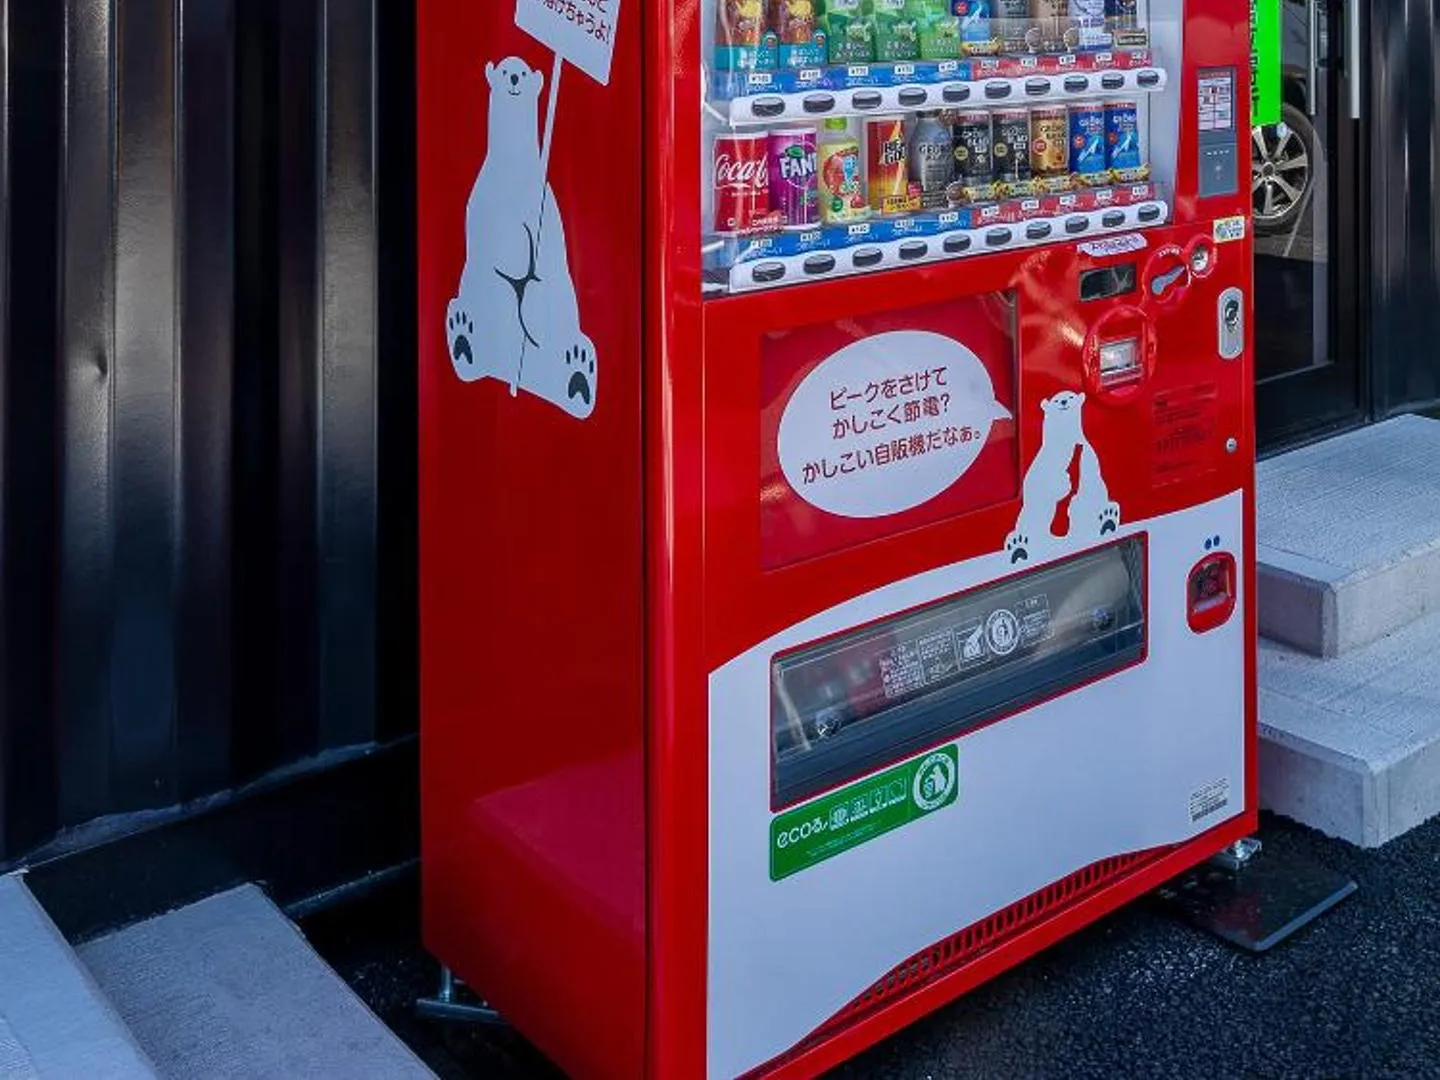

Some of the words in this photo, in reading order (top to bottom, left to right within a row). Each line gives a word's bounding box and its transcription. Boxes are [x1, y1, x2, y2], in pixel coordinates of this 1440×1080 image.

[780, 151, 817, 179] FAN
[829, 367, 948, 411] ピークをさけて
